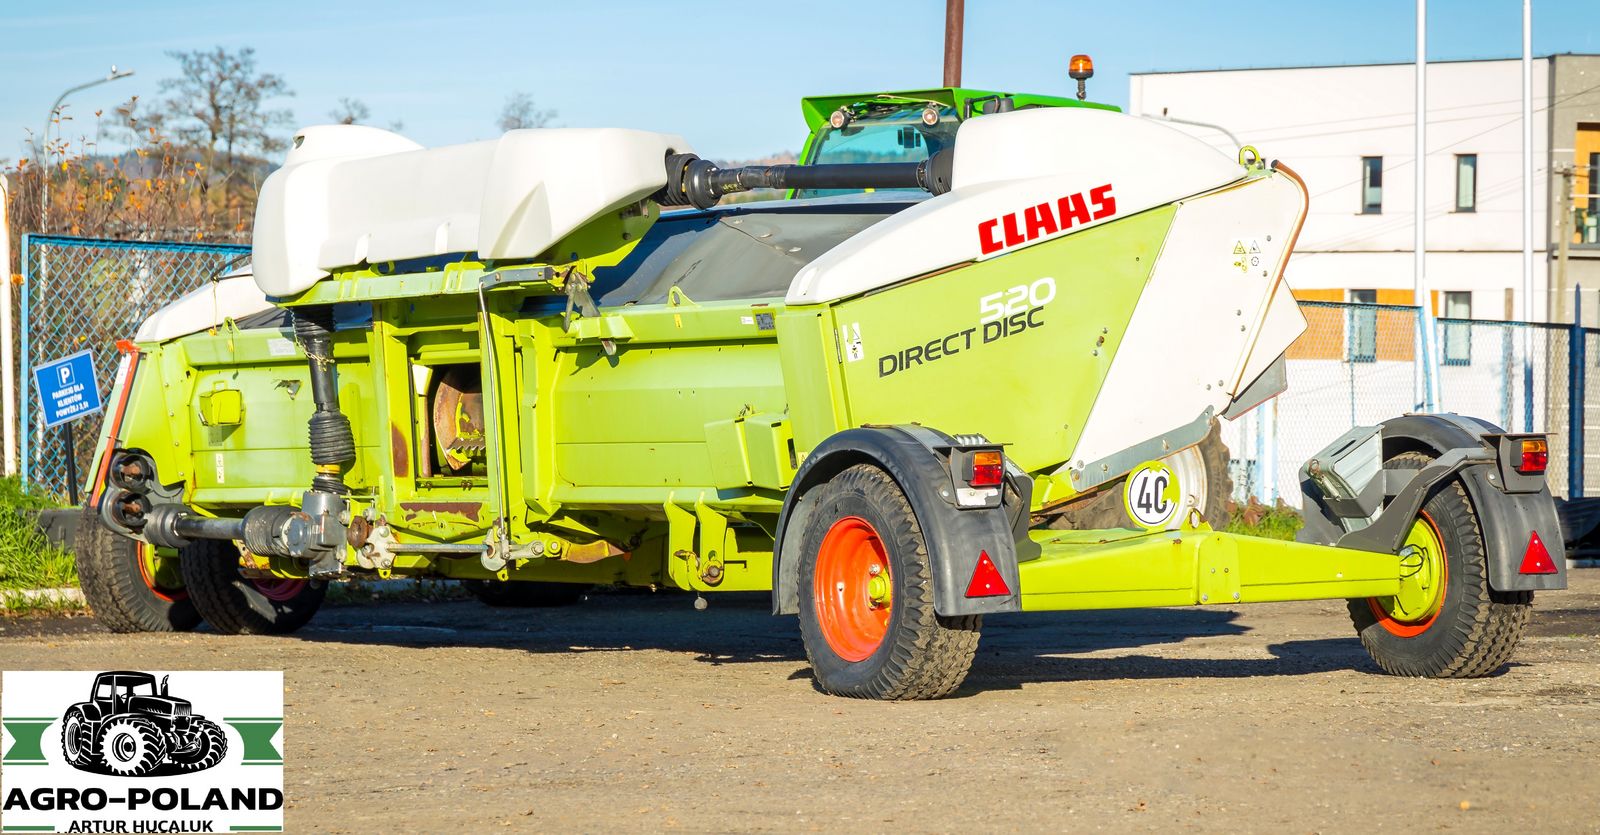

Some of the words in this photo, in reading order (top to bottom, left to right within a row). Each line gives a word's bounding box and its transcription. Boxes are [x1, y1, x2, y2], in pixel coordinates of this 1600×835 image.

[978, 183, 1117, 255] CLAAS
[980, 276, 1057, 325] 520
[878, 327, 977, 378] DIRECT
[983, 305, 1045, 344] DISC
[60, 366, 71, 384] P
[73, 383, 85, 393] DLA
